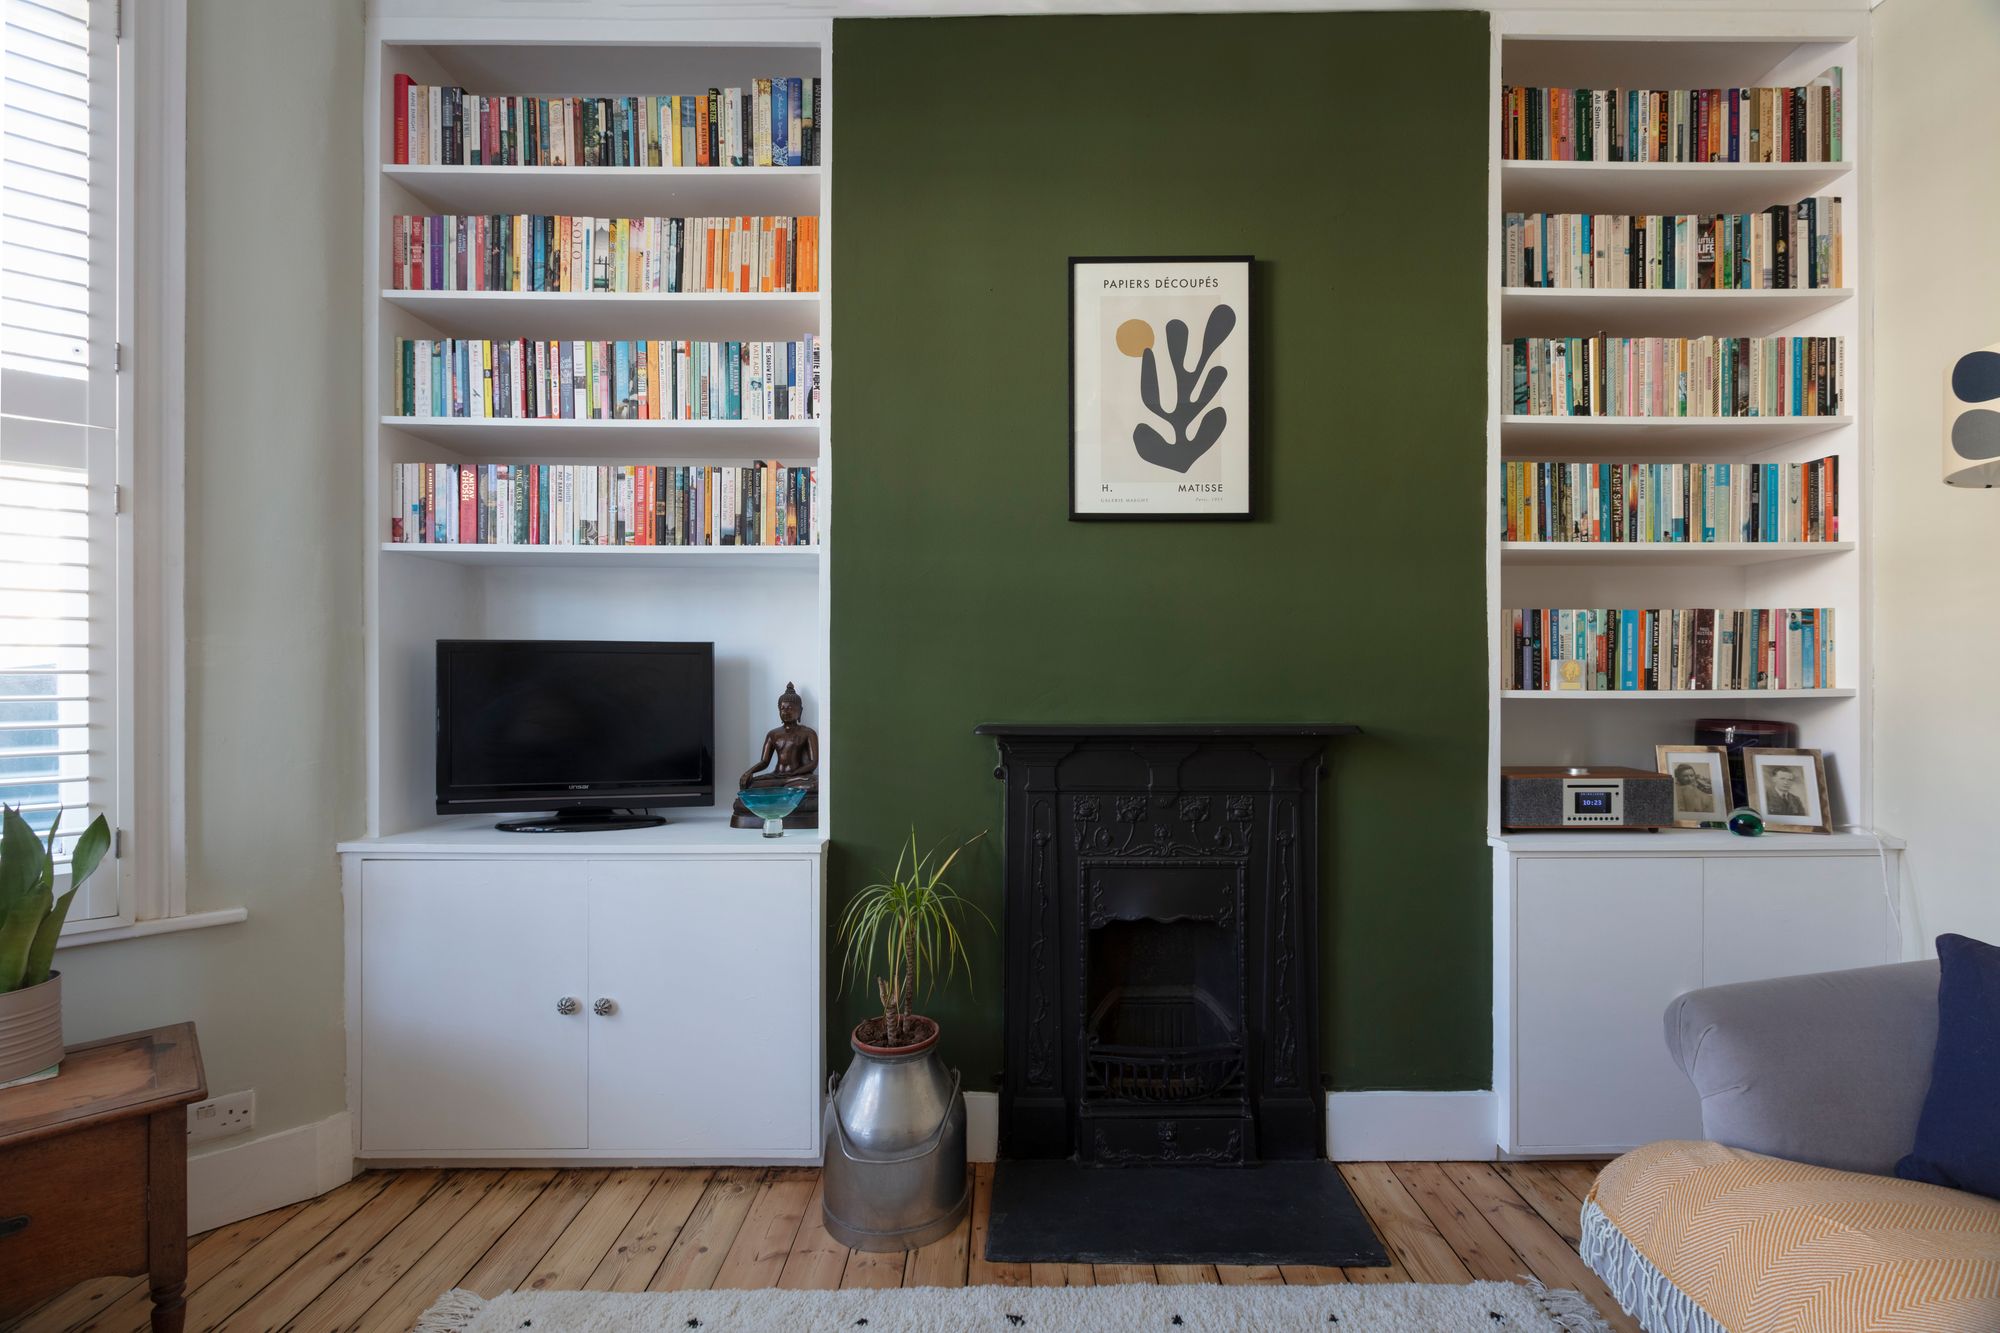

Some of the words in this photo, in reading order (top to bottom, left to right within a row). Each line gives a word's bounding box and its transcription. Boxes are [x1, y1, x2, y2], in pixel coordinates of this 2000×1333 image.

[573, 222, 582, 260] SOLO
[1699, 244, 1714, 254] LIFE
[1103, 279, 1150, 289] PAPIERS
[1155, 276, 1219, 288] DÉCOUPÉS
[1613, 467, 1622, 492] ZADIE
[1101, 484, 1113, 492] H.
[1178, 483, 1223, 492] MATISSE
[1613, 494, 1622, 521] SMITH
